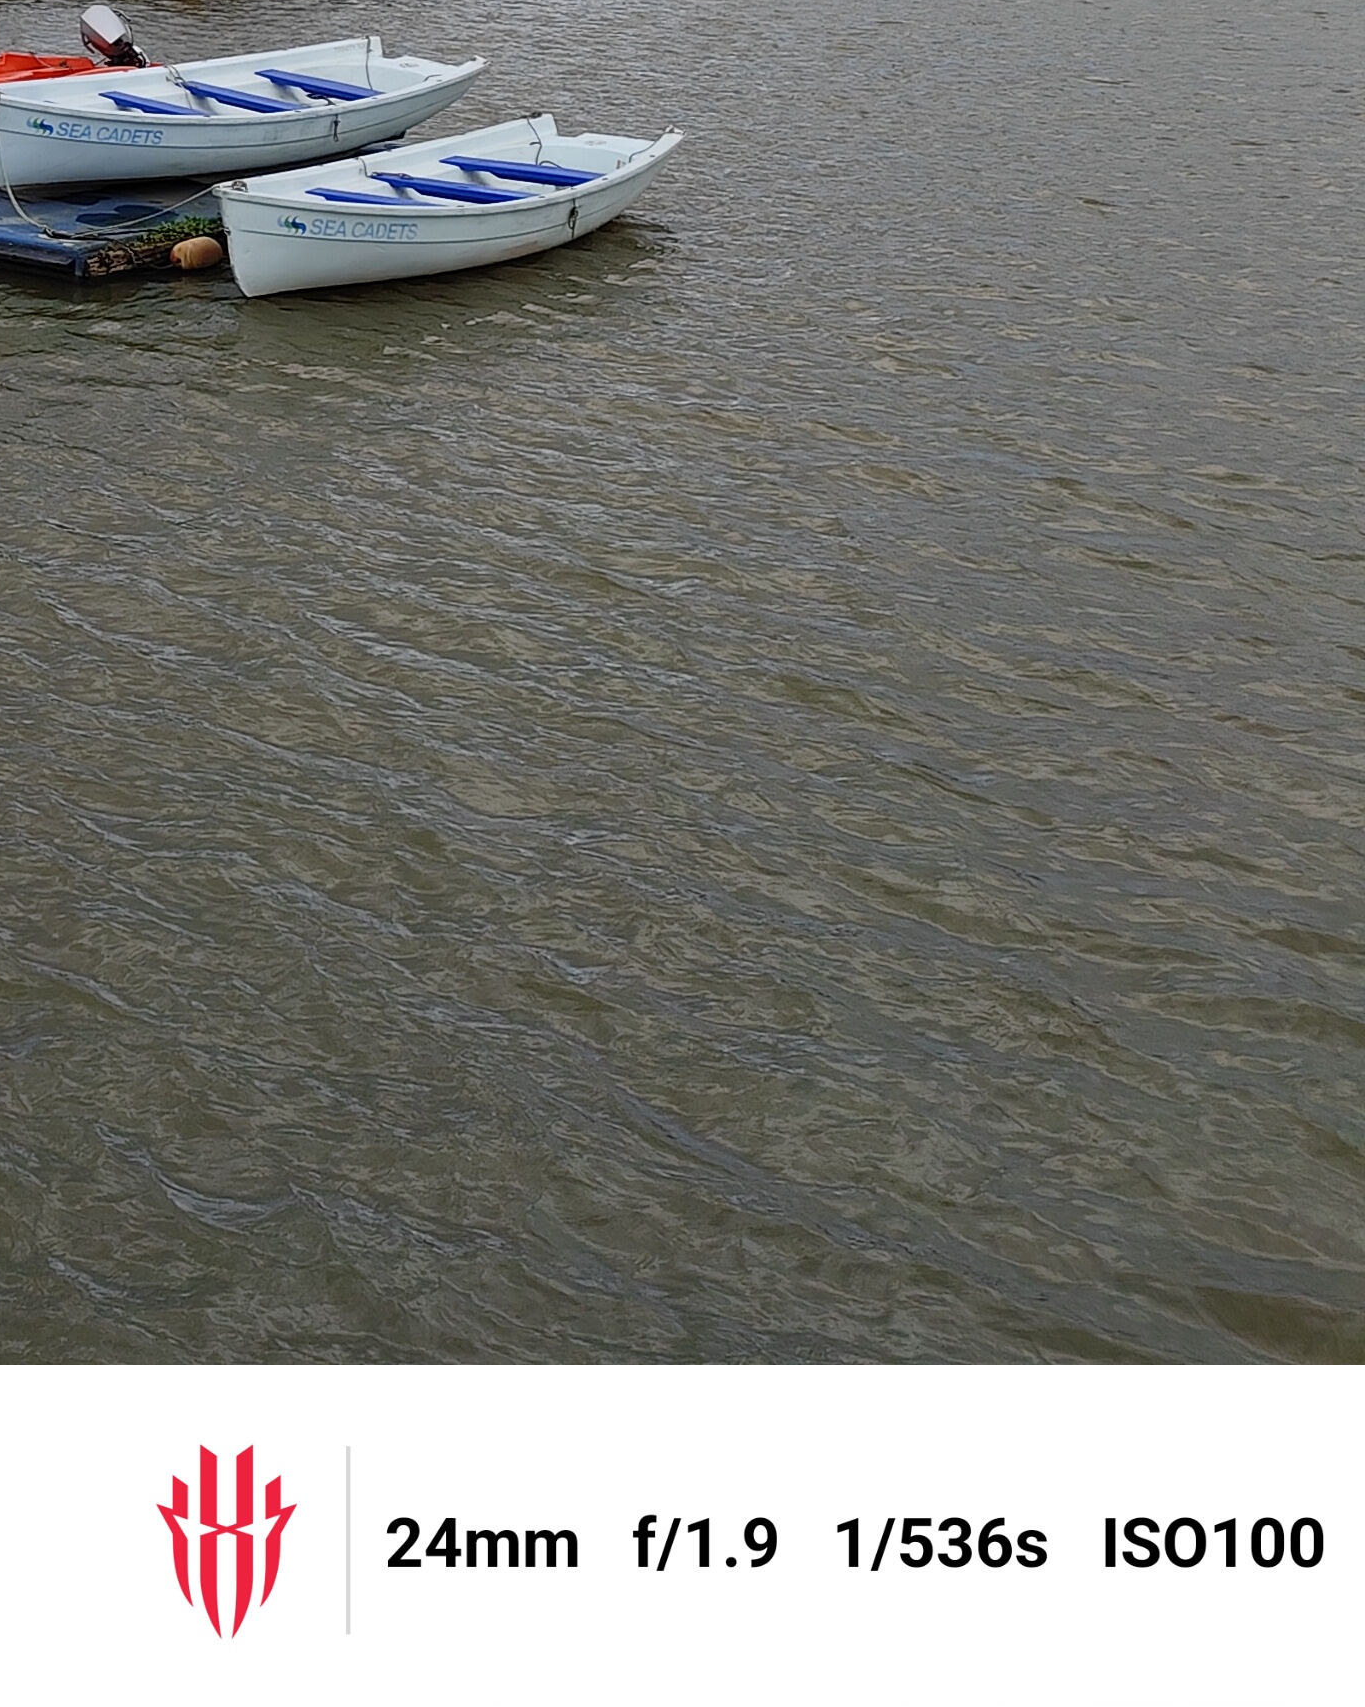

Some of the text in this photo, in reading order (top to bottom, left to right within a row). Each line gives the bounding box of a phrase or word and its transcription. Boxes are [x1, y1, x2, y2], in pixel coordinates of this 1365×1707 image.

[56, 122, 164, 145] SEA CADETS
[310, 218, 418, 240] SEA CADETS
